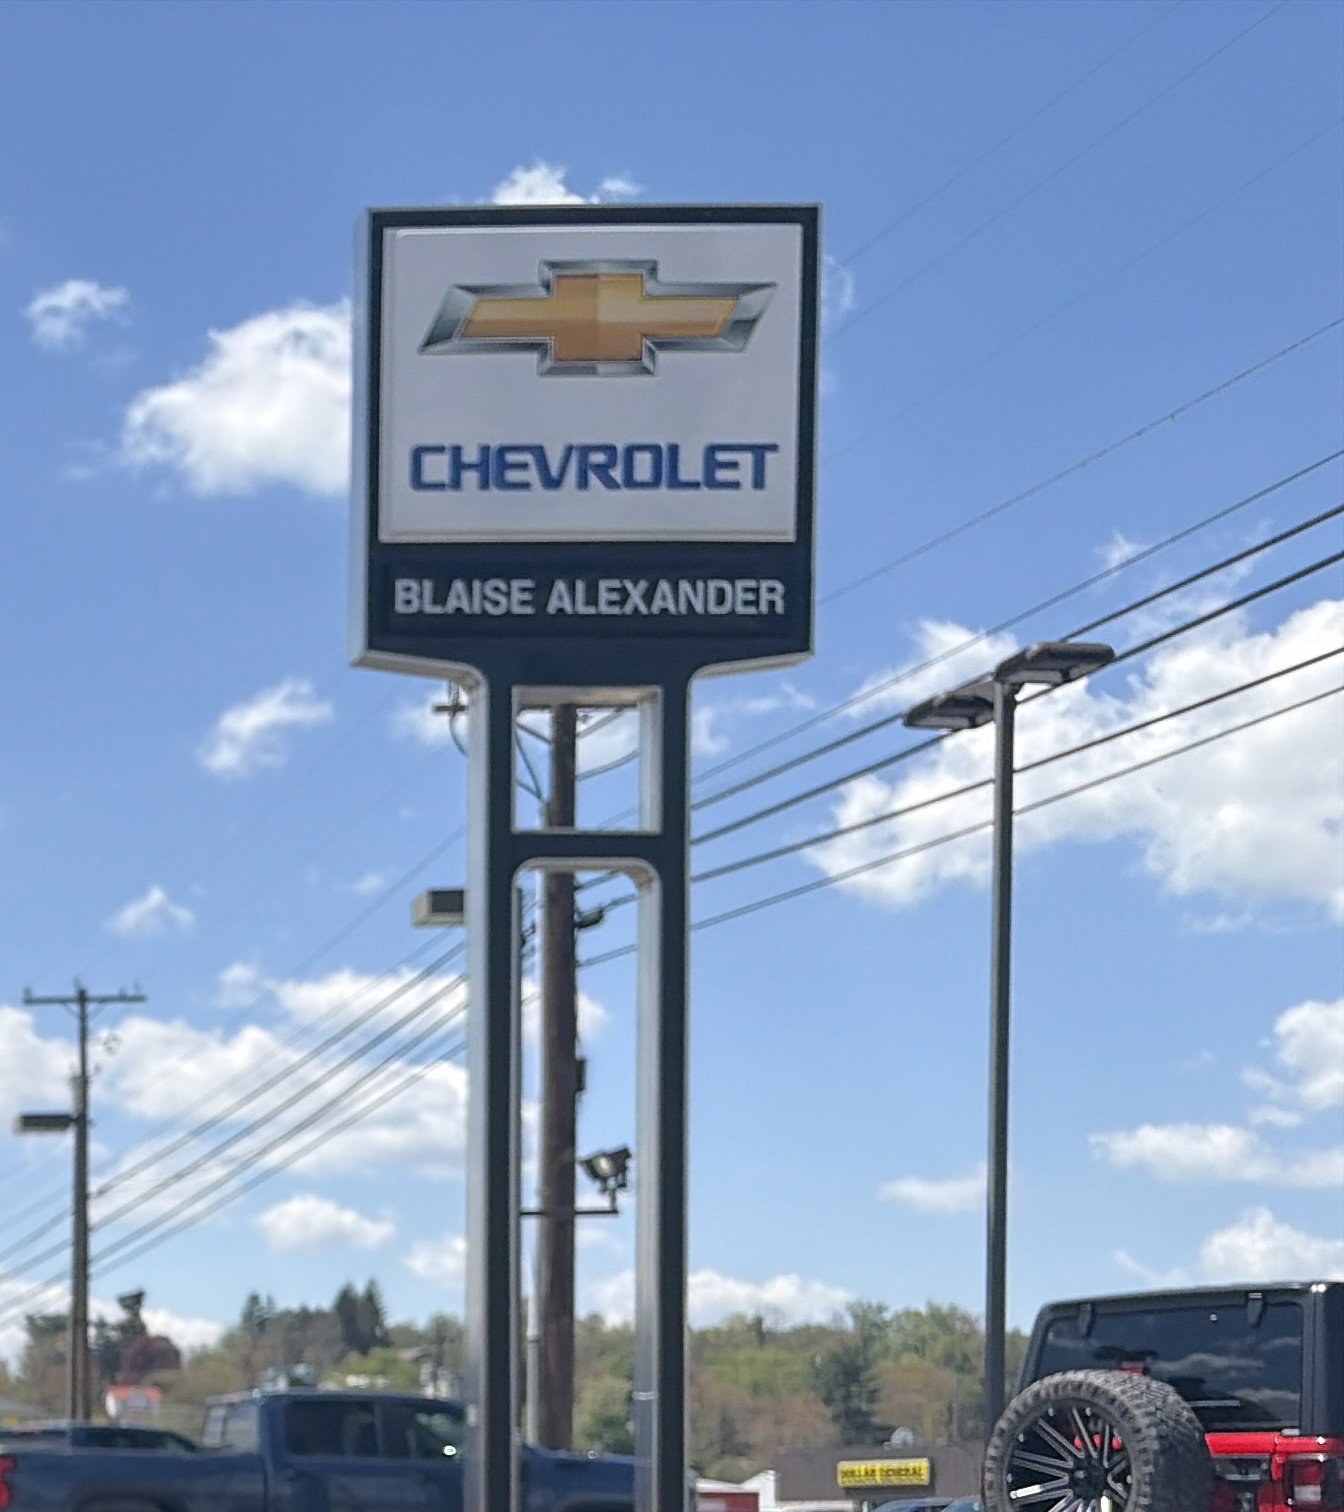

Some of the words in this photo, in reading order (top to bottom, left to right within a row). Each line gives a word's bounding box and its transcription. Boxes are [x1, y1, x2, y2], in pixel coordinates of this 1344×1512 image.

[411, 443, 779, 491] CHEVROLET
[394, 578, 535, 616] BLAISE
[546, 577, 786, 615] ALEXANDER
